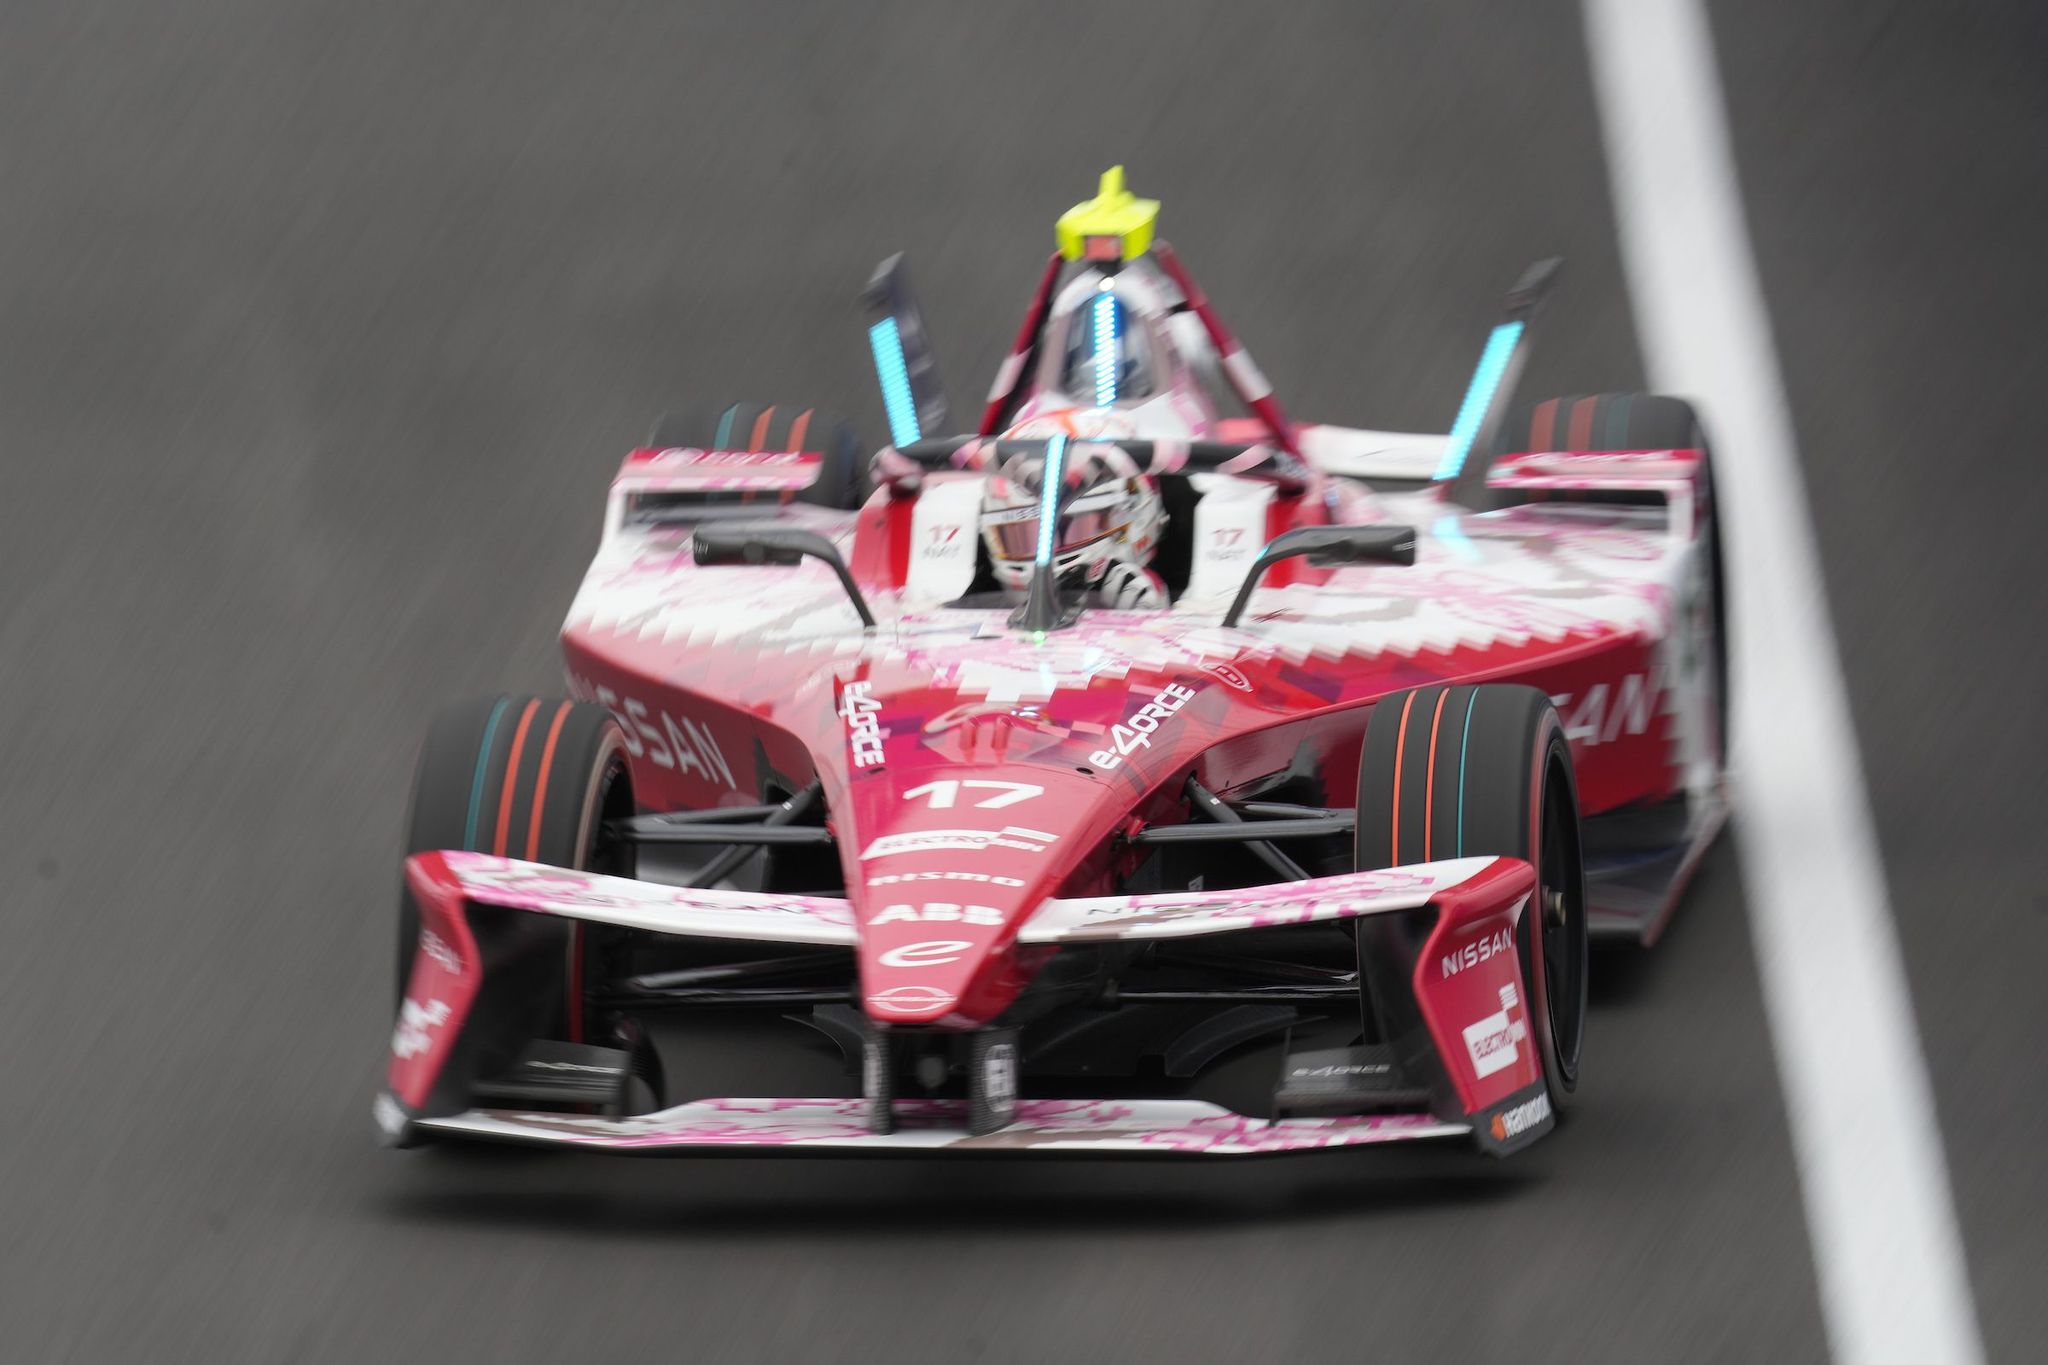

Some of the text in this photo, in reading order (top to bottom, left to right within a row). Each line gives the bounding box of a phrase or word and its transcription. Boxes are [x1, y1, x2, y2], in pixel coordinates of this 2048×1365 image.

[929, 524, 961, 543] 17
[1209, 528, 1246, 546] 17
[903, 780, 1044, 809] 17
[867, 903, 1005, 925] ABB
[1441, 925, 1513, 979] NISSAN
